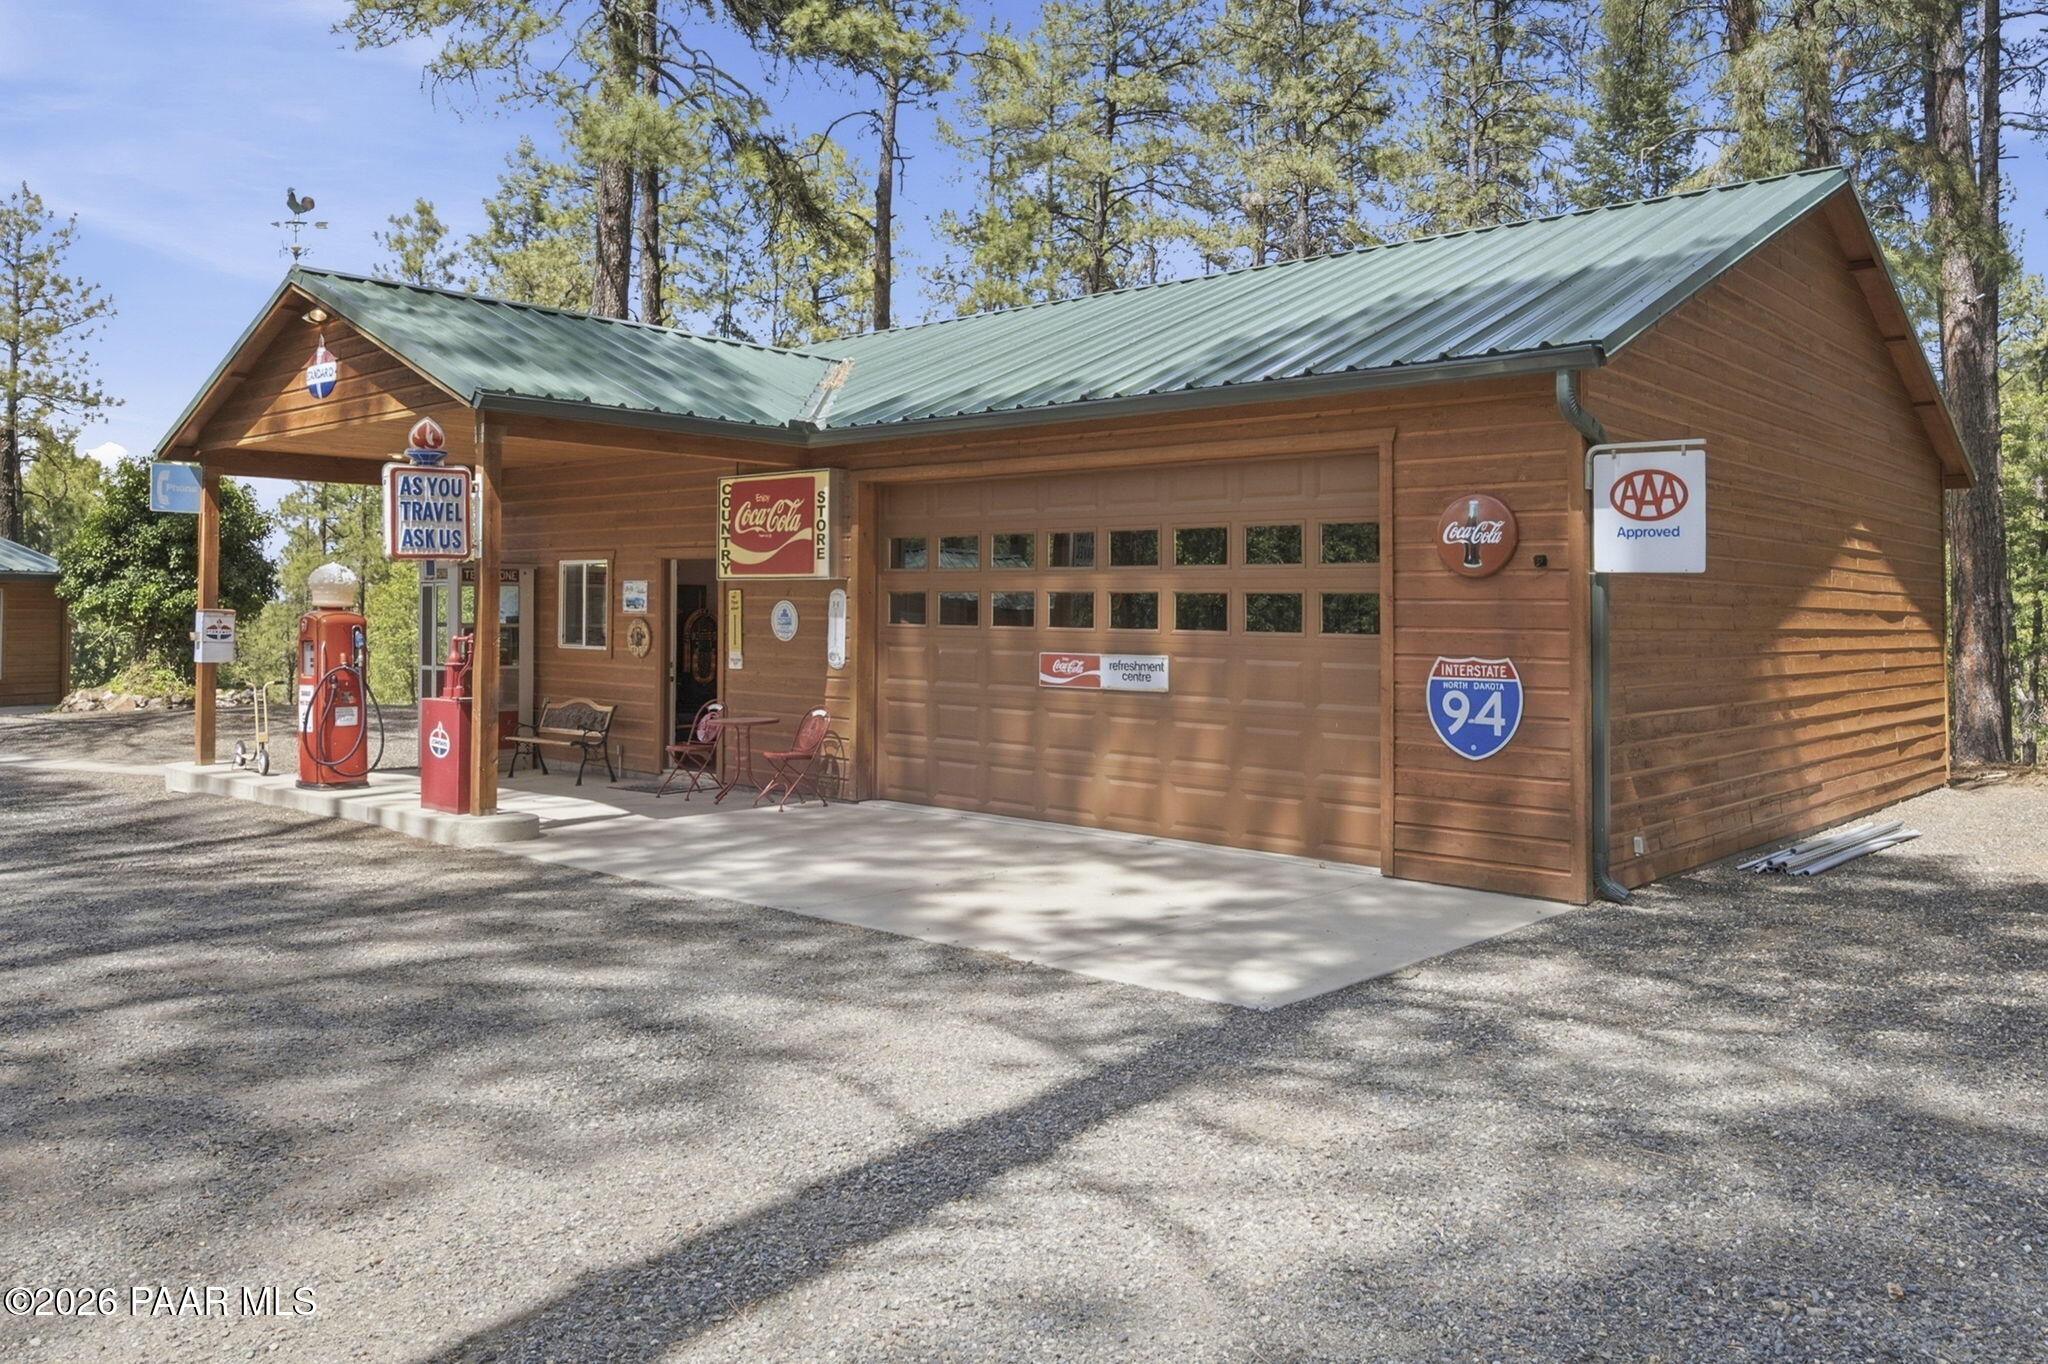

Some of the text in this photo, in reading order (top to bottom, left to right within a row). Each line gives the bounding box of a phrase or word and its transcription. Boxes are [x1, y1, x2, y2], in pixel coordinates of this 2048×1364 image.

[400, 476, 462, 497] AS YOU
[1614, 470, 1685, 521] AAA
[400, 501, 462, 522] TRAVEL
[735, 498, 805, 534] Coca-Cola
[721, 483, 732, 575] COUNTRY
[816, 490, 826, 560] STORE
[1443, 520, 1505, 544] Coca-Cola
[1617, 526, 1680, 540] Approved
[402, 528, 462, 549] ASK US
[1052, 659, 1085, 673] Coca-Cola
[1109, 660, 1164, 672] refreshment
[1441, 663, 1507, 678] INTERSTATE
[1122, 672, 1152, 682] centre
[1443, 681, 1504, 691] NORTH DAKOTA
[1442, 690, 1506, 736] 94
